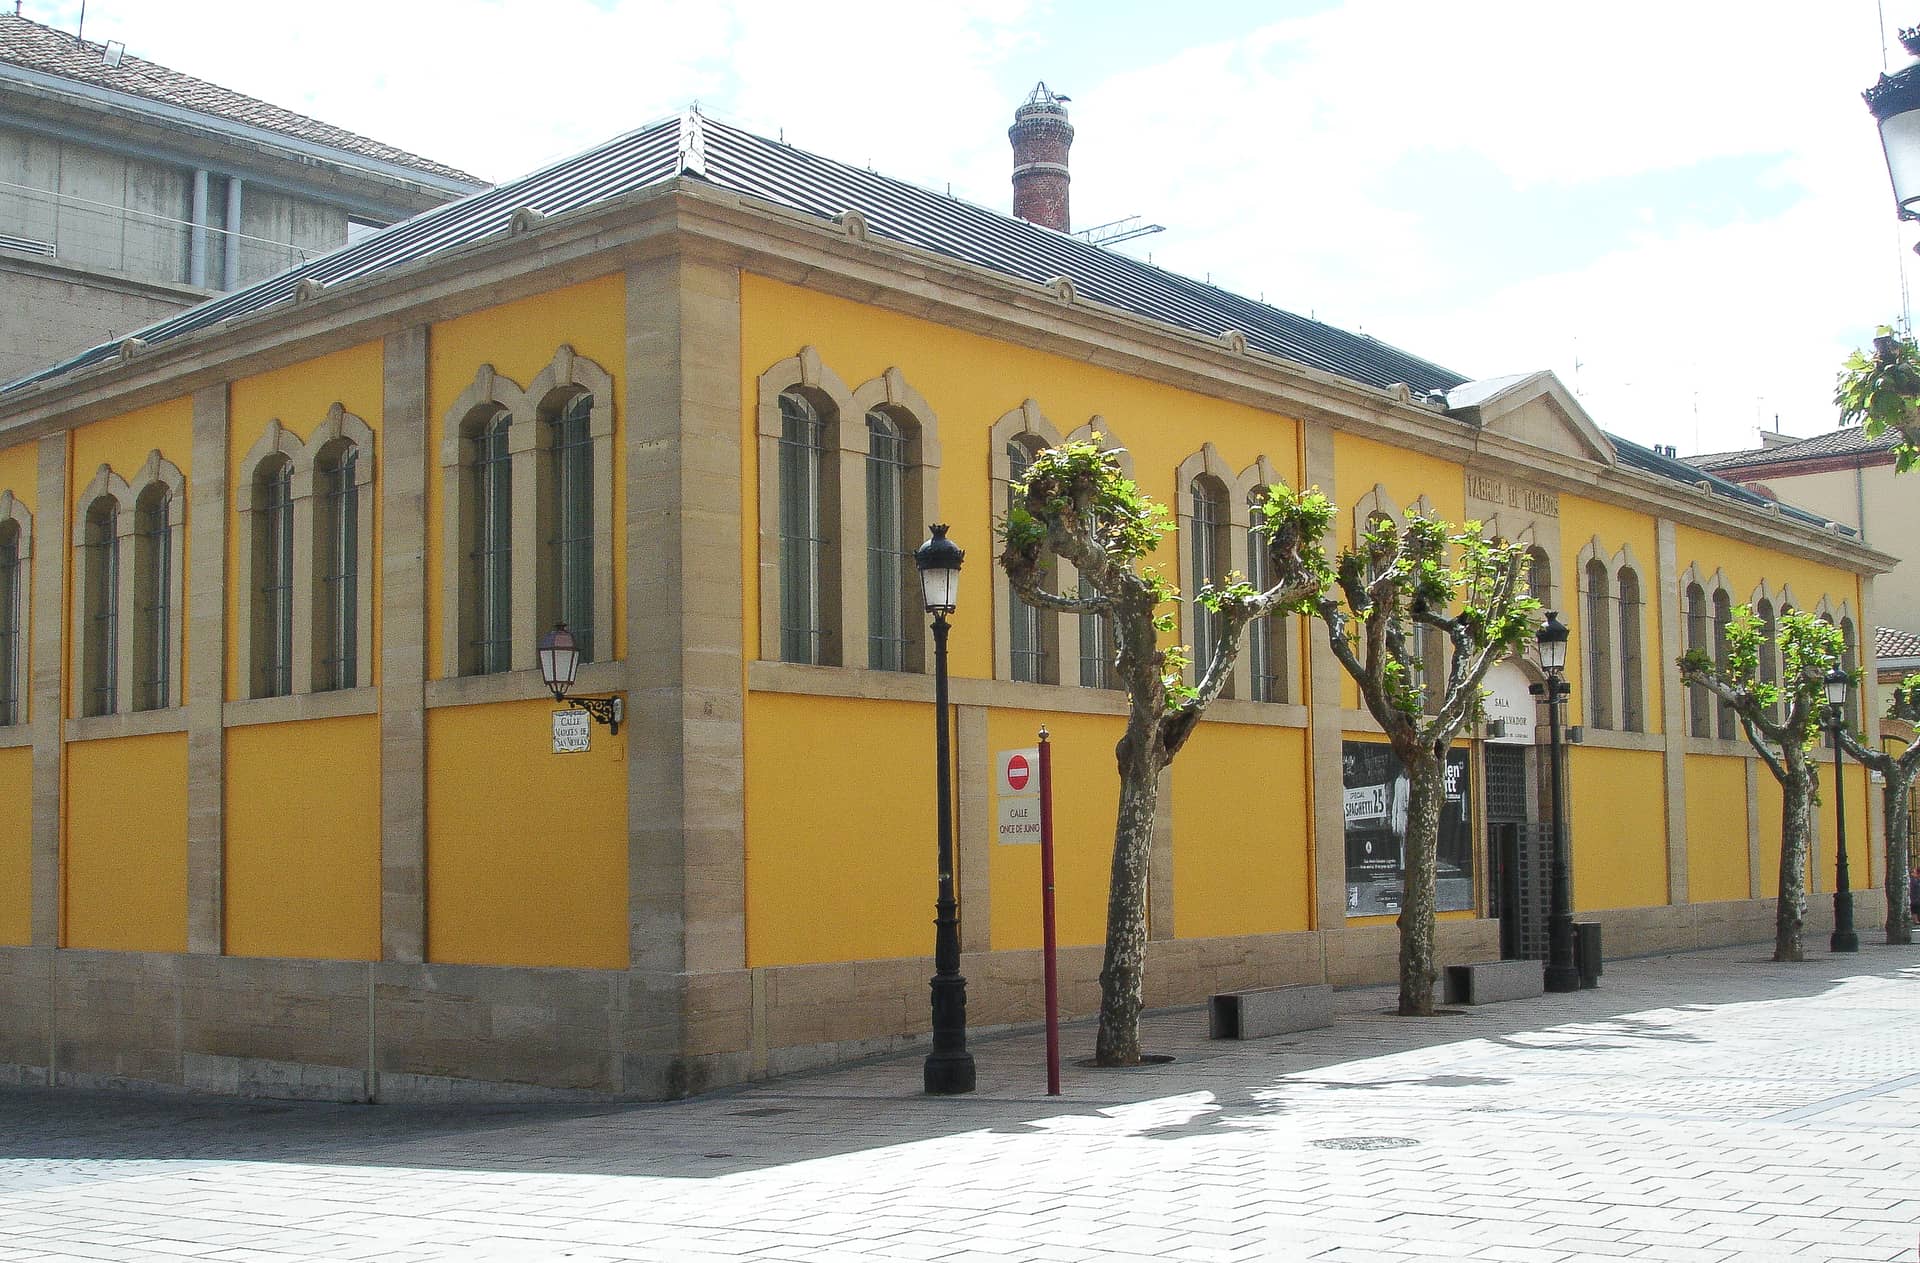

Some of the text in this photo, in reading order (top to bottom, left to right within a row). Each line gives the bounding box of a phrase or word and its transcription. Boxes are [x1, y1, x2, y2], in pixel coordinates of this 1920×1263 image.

[1495, 698, 1509, 707] SALA
[561, 717, 580, 727] CALLE
[1345, 789, 1384, 817] SPAGHETTI 25
[1010, 809, 1028, 818] CALLE
[1000, 823, 1040, 834] ONCE DE JUNIO
